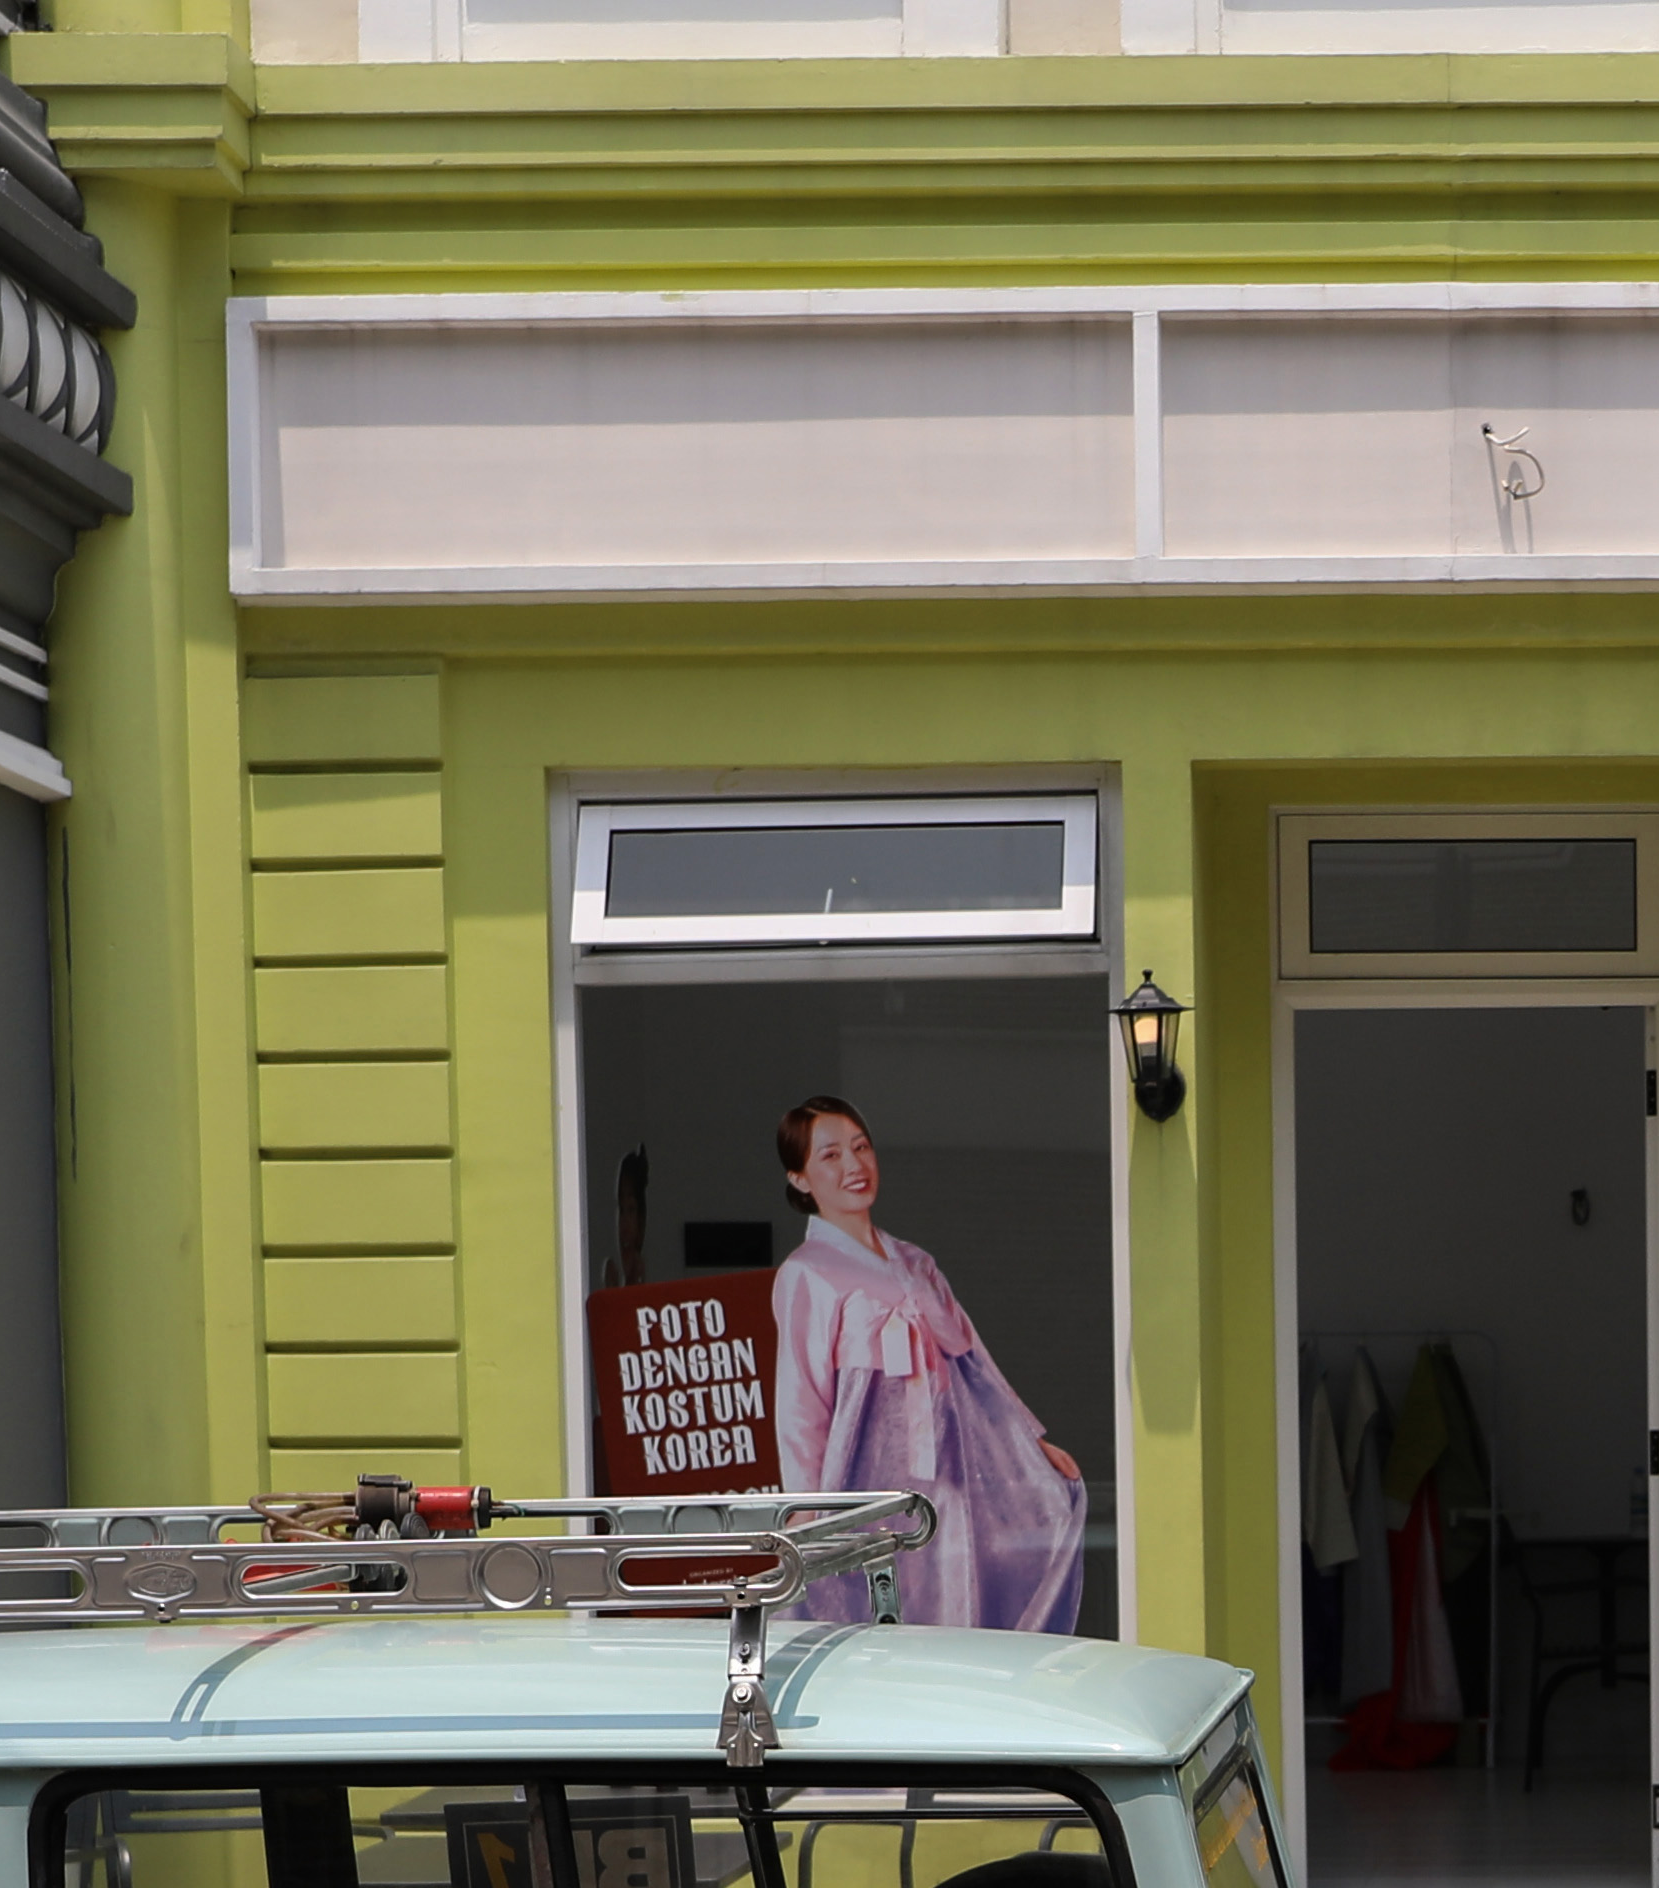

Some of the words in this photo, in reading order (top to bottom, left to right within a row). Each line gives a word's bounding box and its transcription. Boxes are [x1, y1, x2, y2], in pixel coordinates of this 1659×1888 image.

[636, 1298, 726, 1347] FOTO
[619, 1337, 757, 1392] DENGAN
[621, 1380, 765, 1435] KOSTUM
[642, 1425, 757, 1476] KOREA
